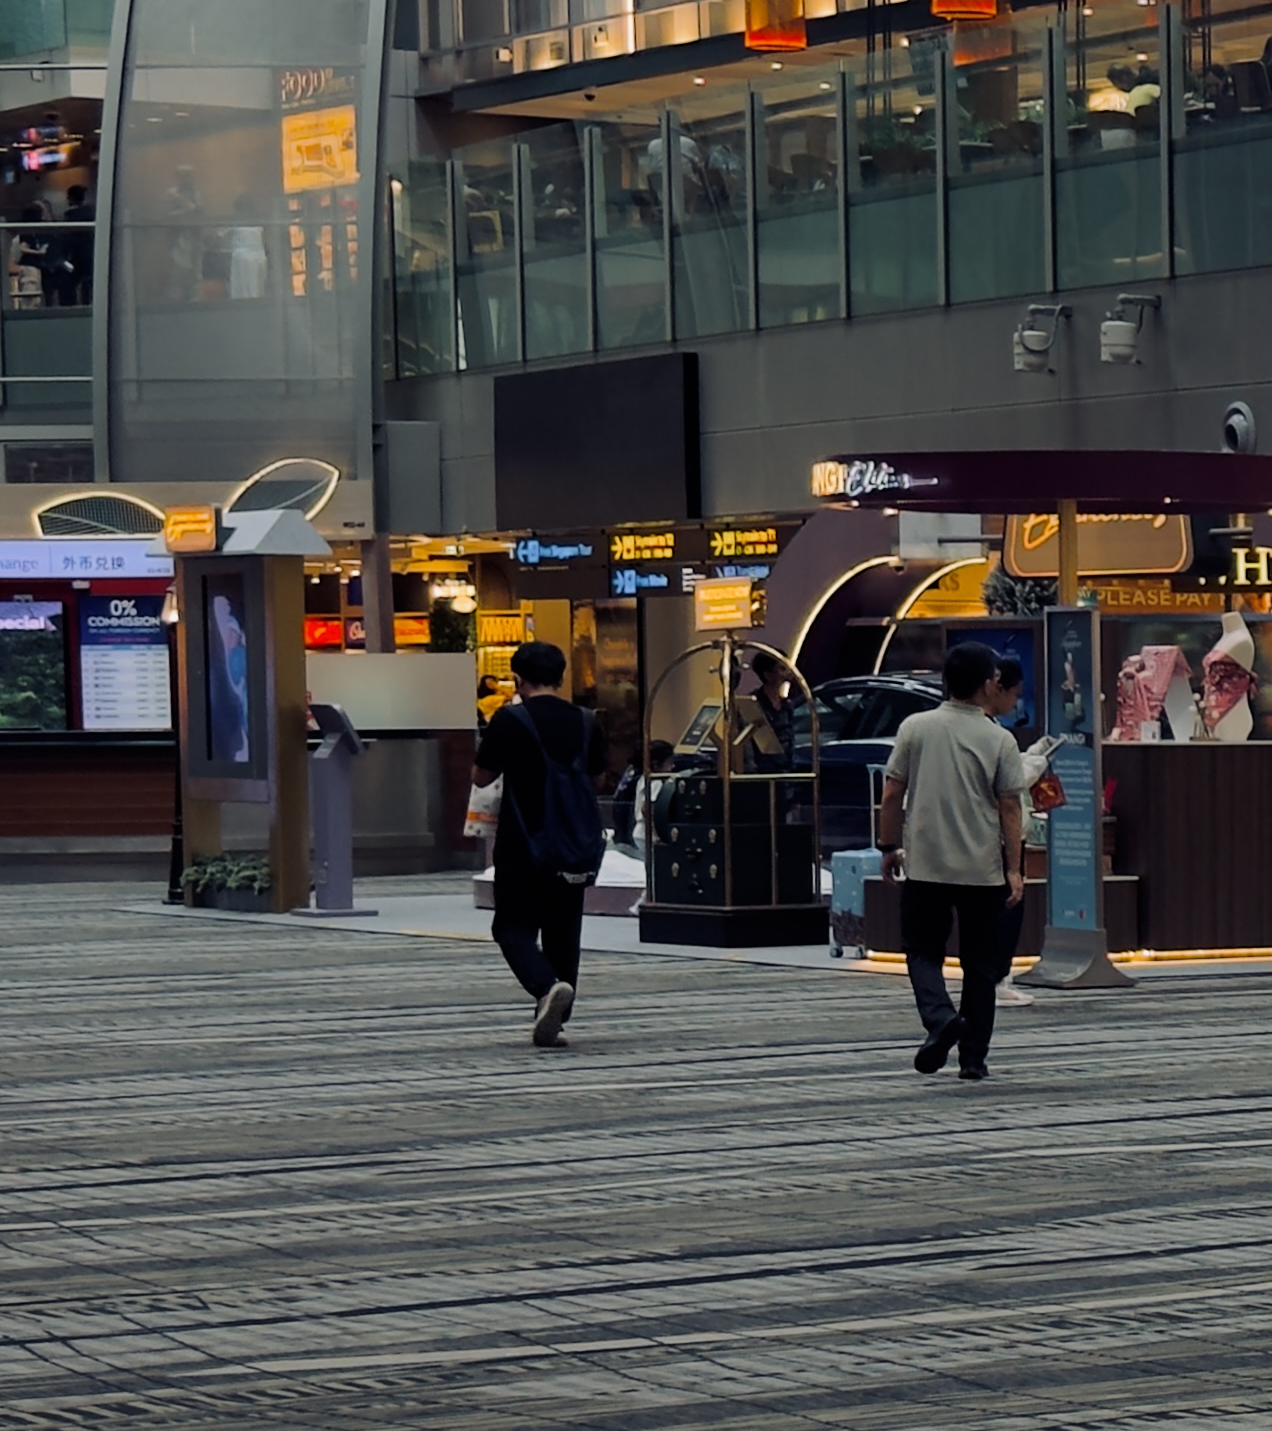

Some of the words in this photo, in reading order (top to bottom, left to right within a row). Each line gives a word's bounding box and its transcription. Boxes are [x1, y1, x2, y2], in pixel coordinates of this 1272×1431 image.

[63, 556, 125, 571] 外币兑换
[1175, 592, 1211, 606] PAY
[109, 600, 138, 616] 0%
[88, 616, 160, 626] COMMISSION
